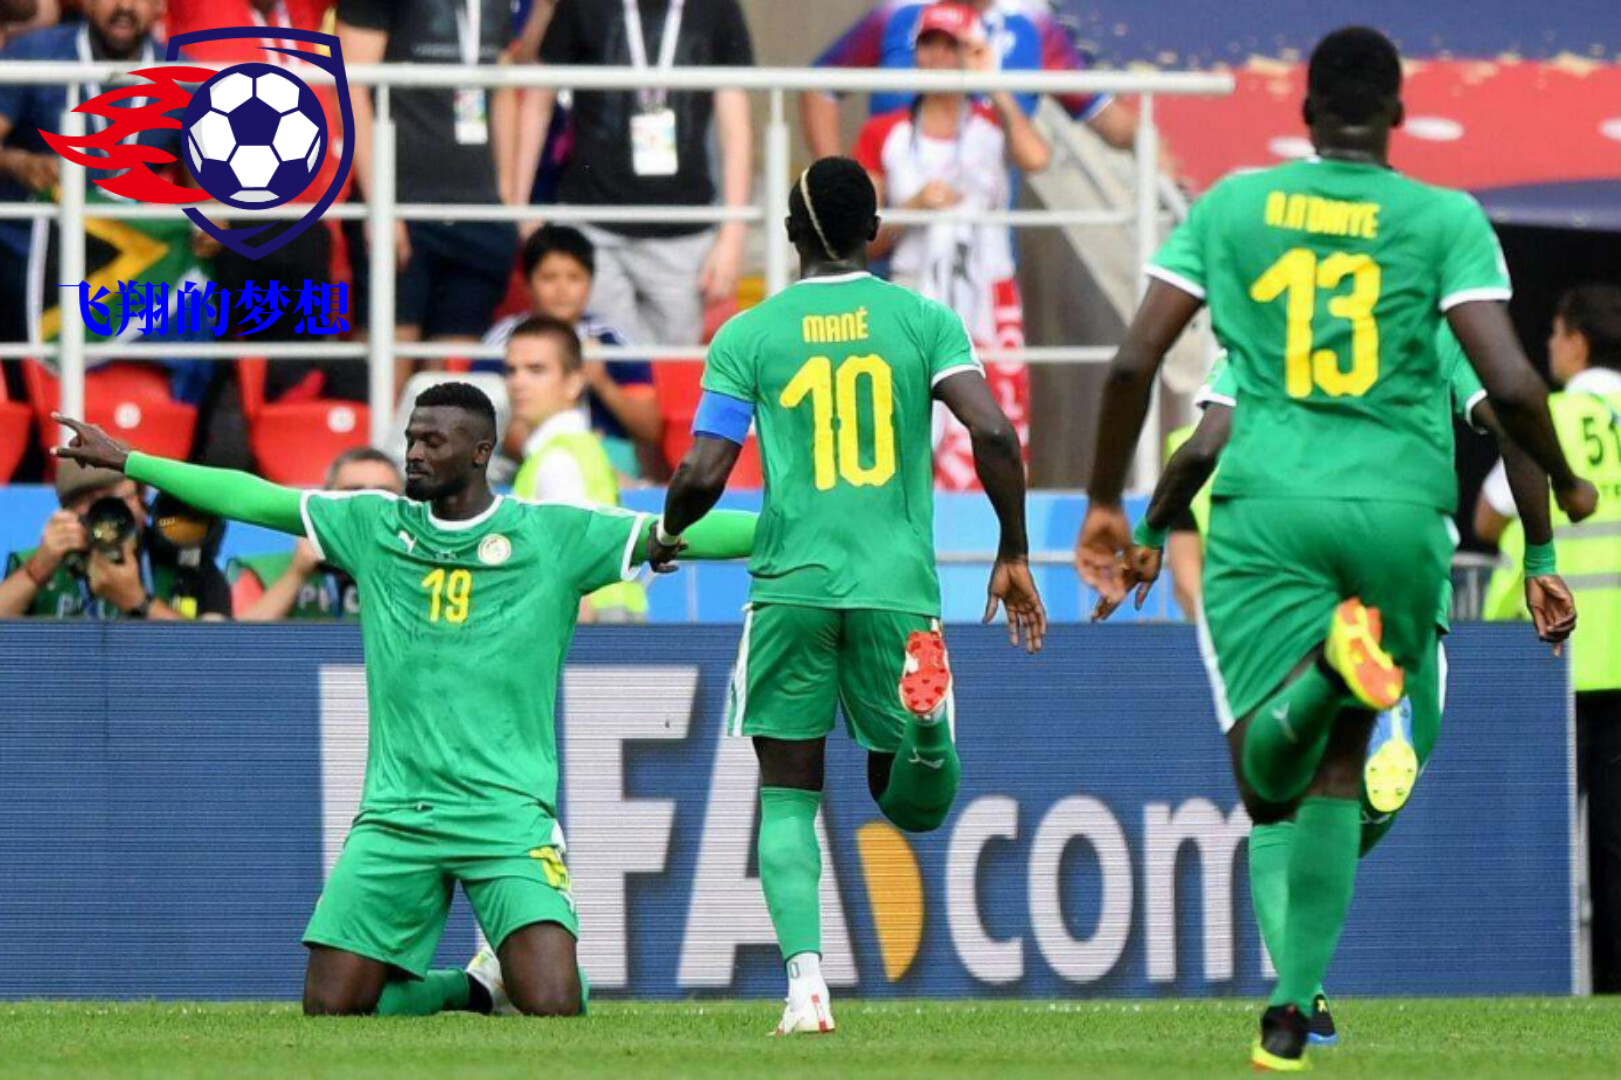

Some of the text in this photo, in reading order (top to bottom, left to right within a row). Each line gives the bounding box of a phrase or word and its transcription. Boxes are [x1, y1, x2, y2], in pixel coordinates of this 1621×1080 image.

[803, 306, 869, 344] MANÉ
[1251, 248, 1382, 398] 13
[779, 353, 896, 491] 10
[421, 568, 473, 624] 19
